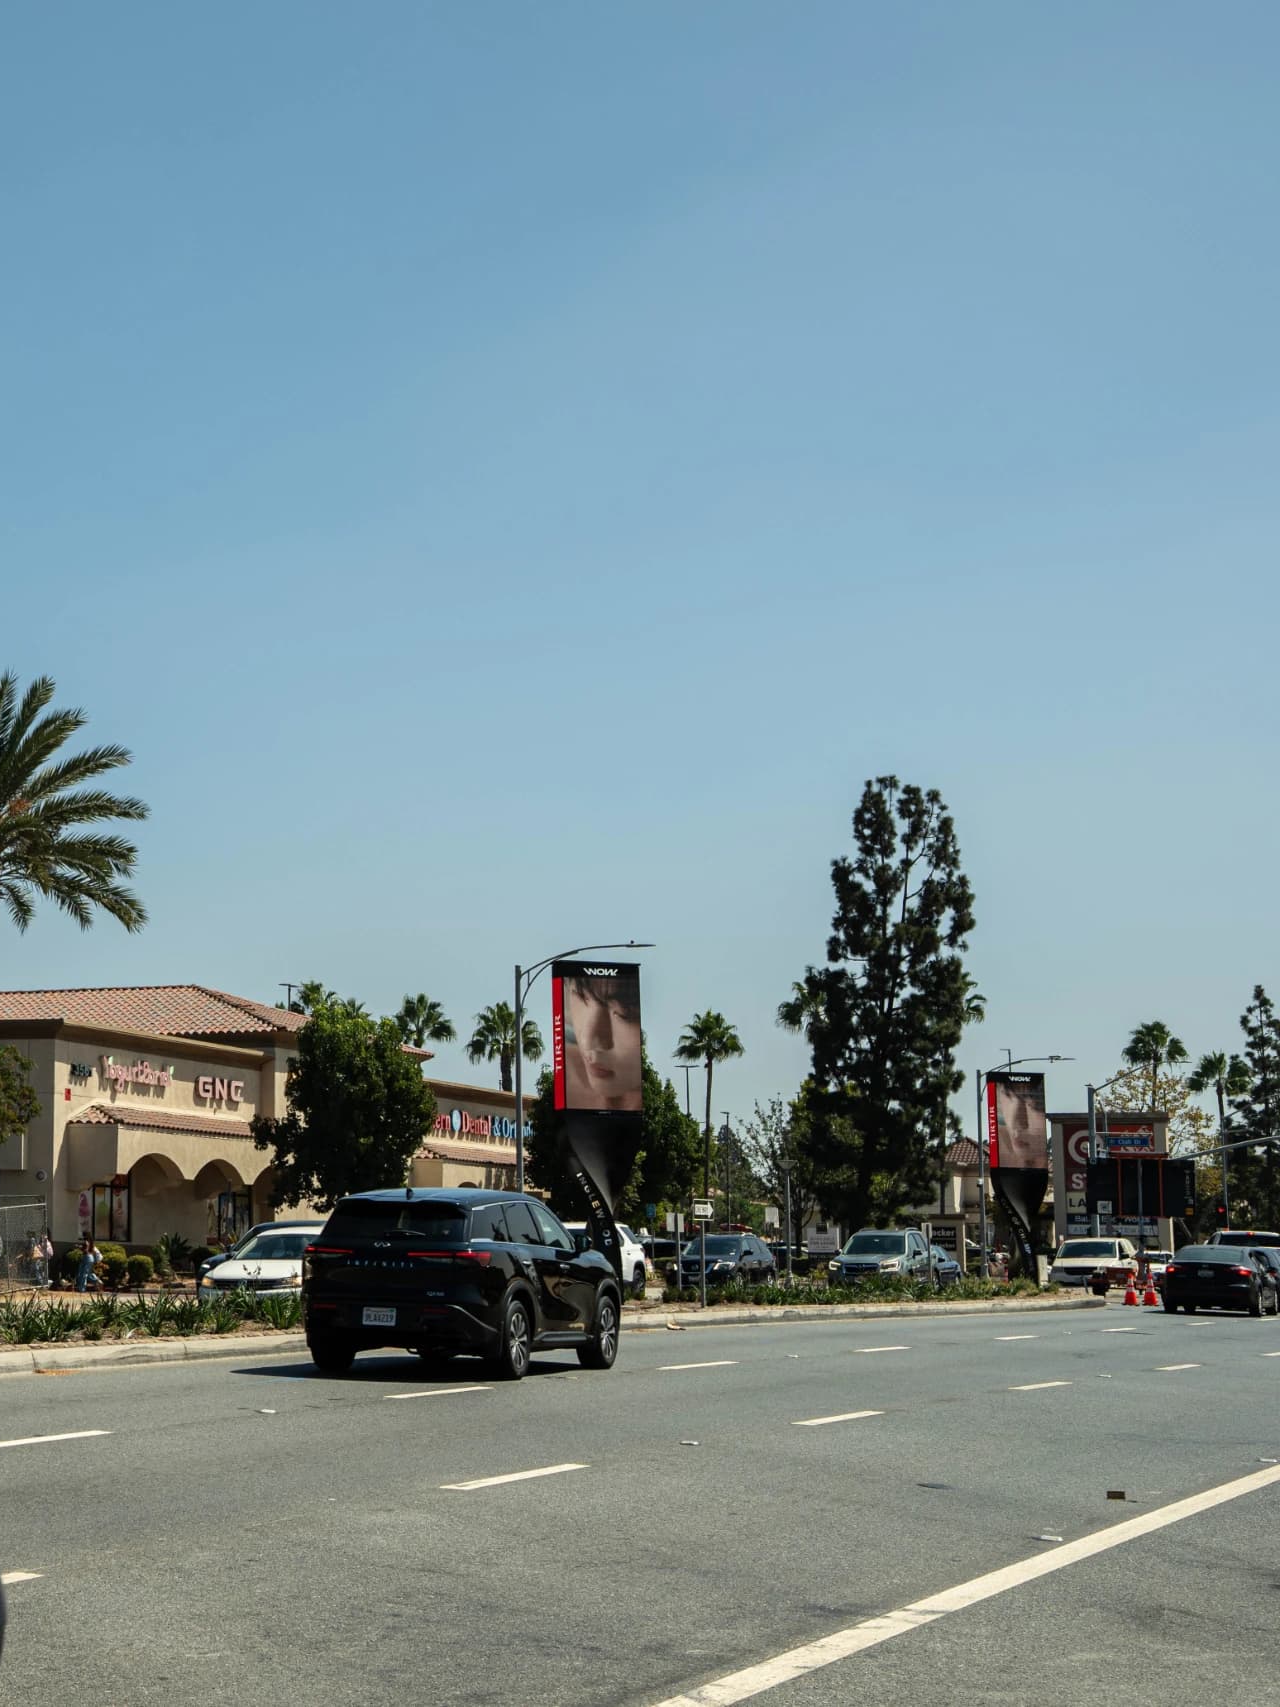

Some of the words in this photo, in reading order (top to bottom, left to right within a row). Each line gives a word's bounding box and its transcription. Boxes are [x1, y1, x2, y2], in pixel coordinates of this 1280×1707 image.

[554, 1014, 563, 1072] TIRTIR
[197, 1075, 244, 1102] GNC
[462, 1111, 491, 1137] Dental
